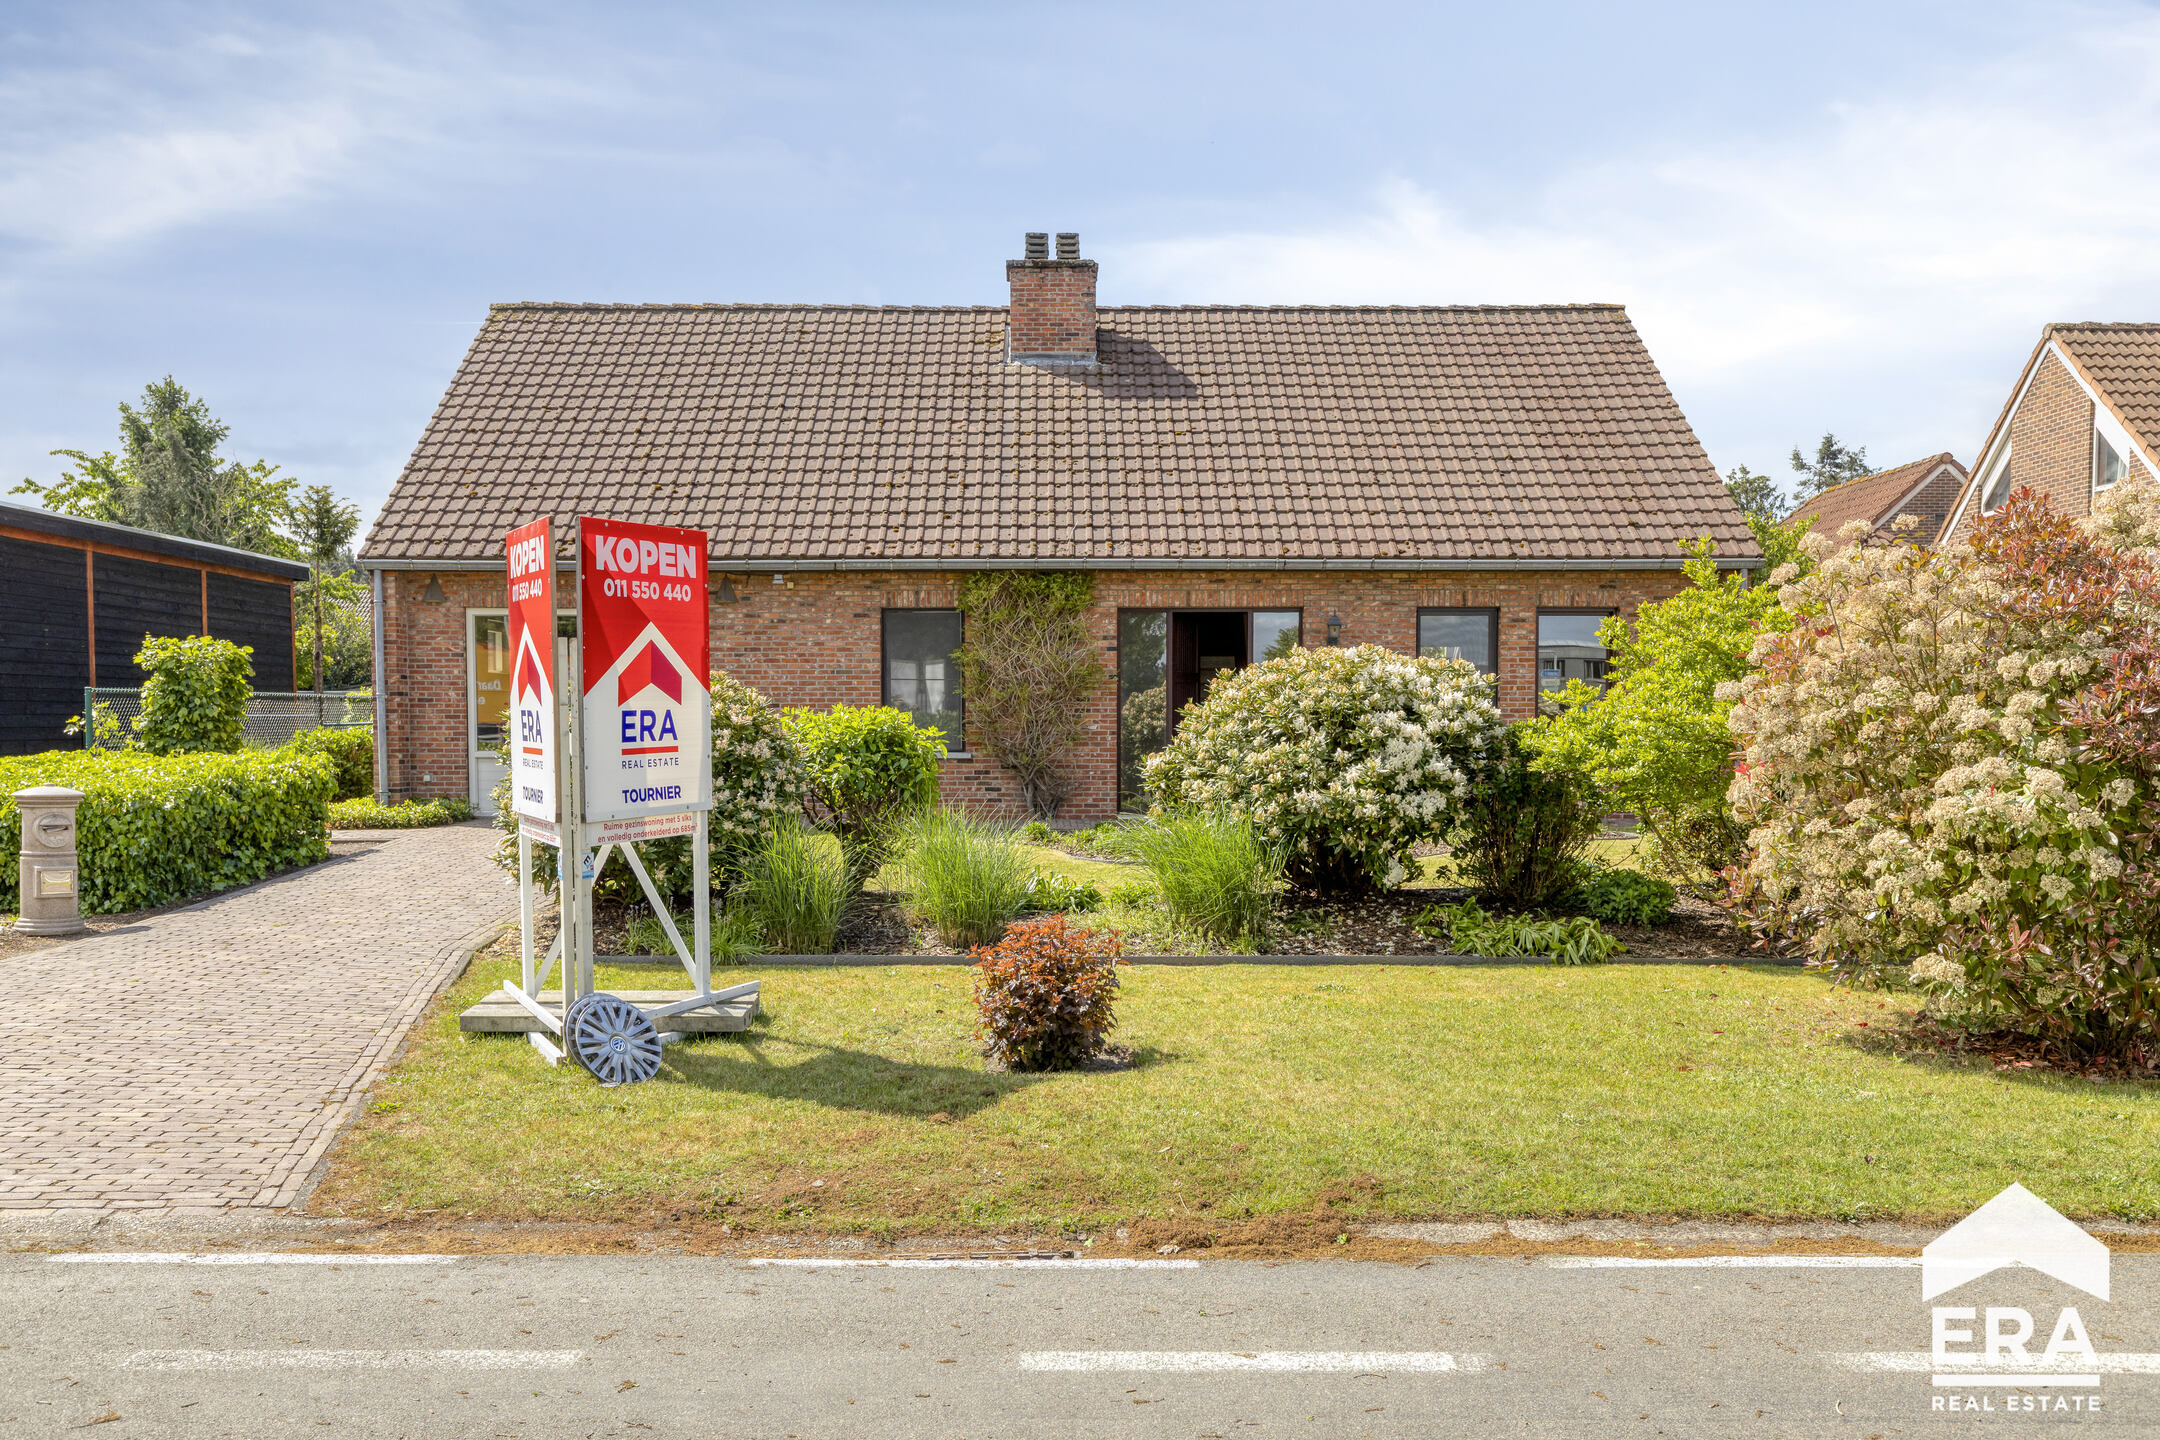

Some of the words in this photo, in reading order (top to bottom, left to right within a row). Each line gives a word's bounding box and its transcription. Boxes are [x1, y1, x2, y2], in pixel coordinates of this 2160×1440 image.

[510, 535, 545, 579] KOPEN
[595, 535, 697, 579] KOPEN
[519, 582, 529, 601] 550
[530, 578, 543, 598] 440
[603, 578, 628, 597] 011
[631, 581, 660, 600] 550
[663, 583, 691, 602] 440
[520, 709, 543, 744] ERA
[621, 709, 678, 743] ERA
[621, 758, 644, 770] REAL
[647, 757, 679, 768] ESTATE
[522, 786, 544, 804] TOURNIER
[622, 784, 682, 804] TOURNIER
[597, 835, 605, 843] en
[607, 832, 631, 842] volledig
[633, 827, 671, 838] onderkelderd
[672, 828, 680, 836] op
[604, 822, 623, 831] Ruime
[625, 818, 664, 830] gezinswoning
[665, 816, 676, 824] met
